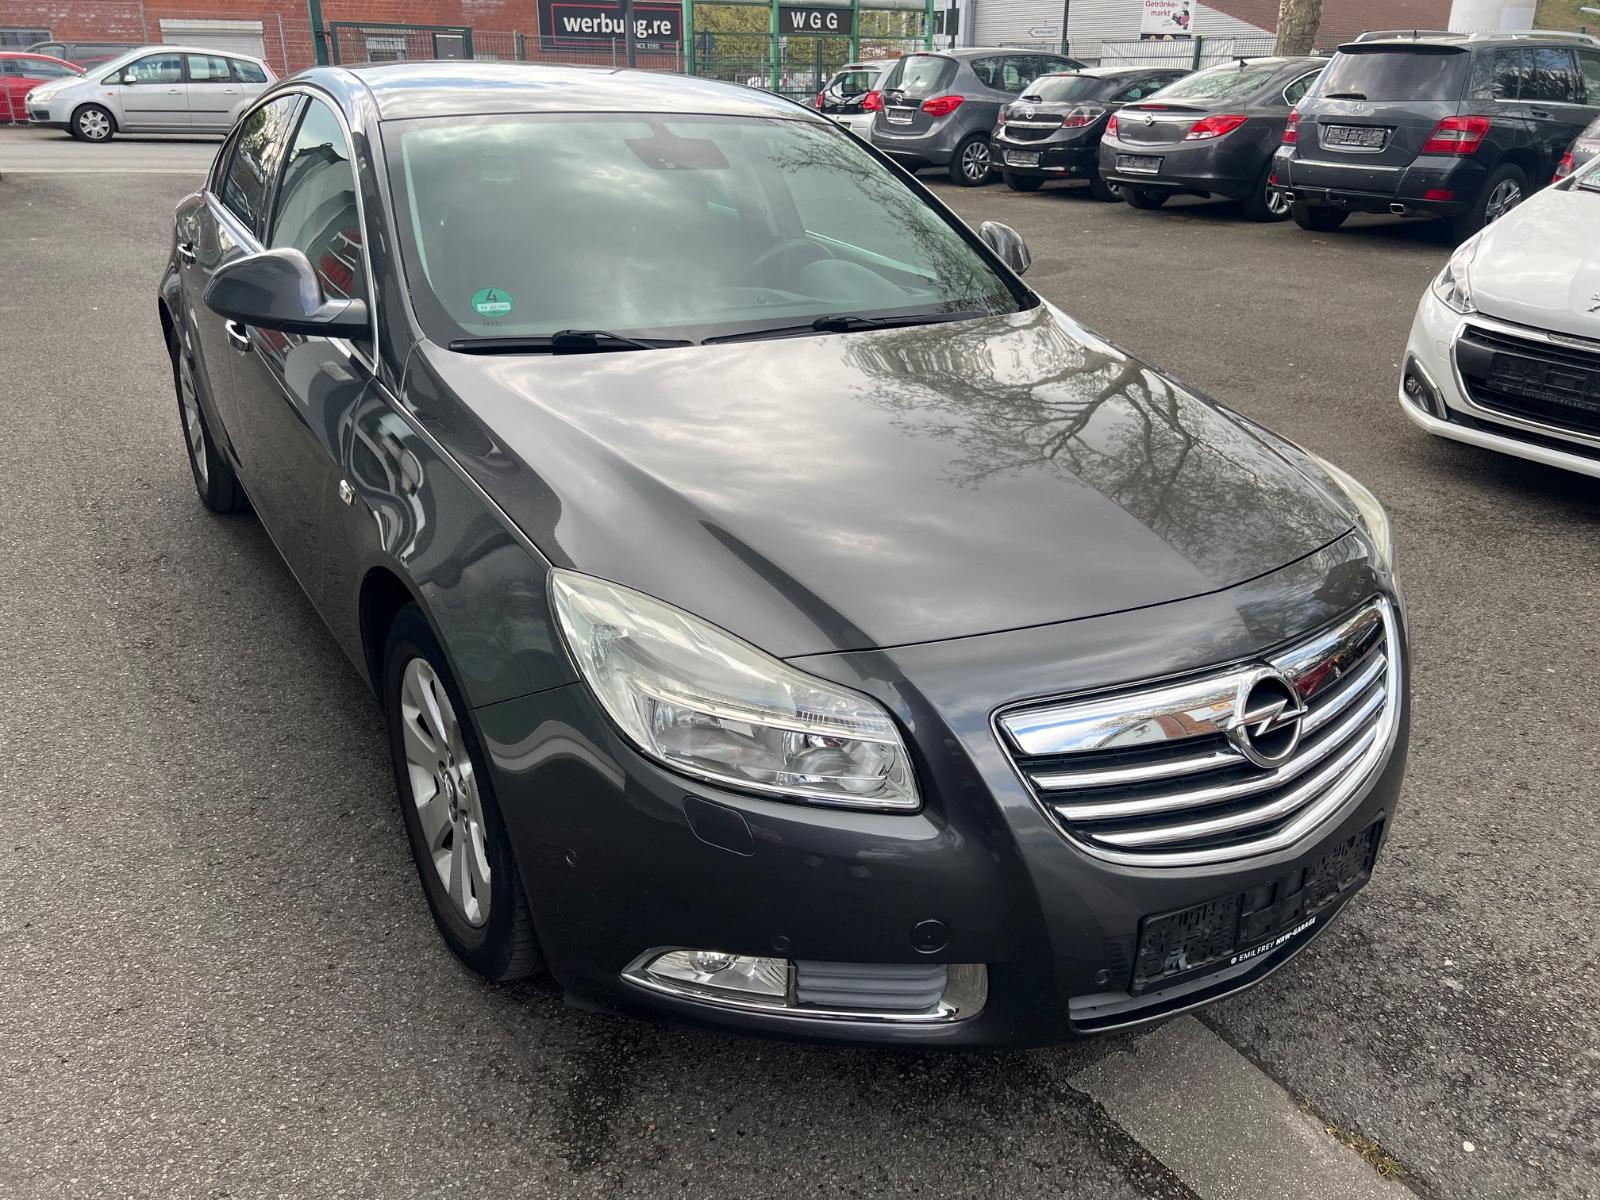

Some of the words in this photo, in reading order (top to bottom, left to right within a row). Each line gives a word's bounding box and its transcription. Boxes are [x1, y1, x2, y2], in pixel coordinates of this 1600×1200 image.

[486, 289, 498, 302] 4
[1239, 950, 1256, 962] EMIL
[1257, 940, 1275, 954] FREY
